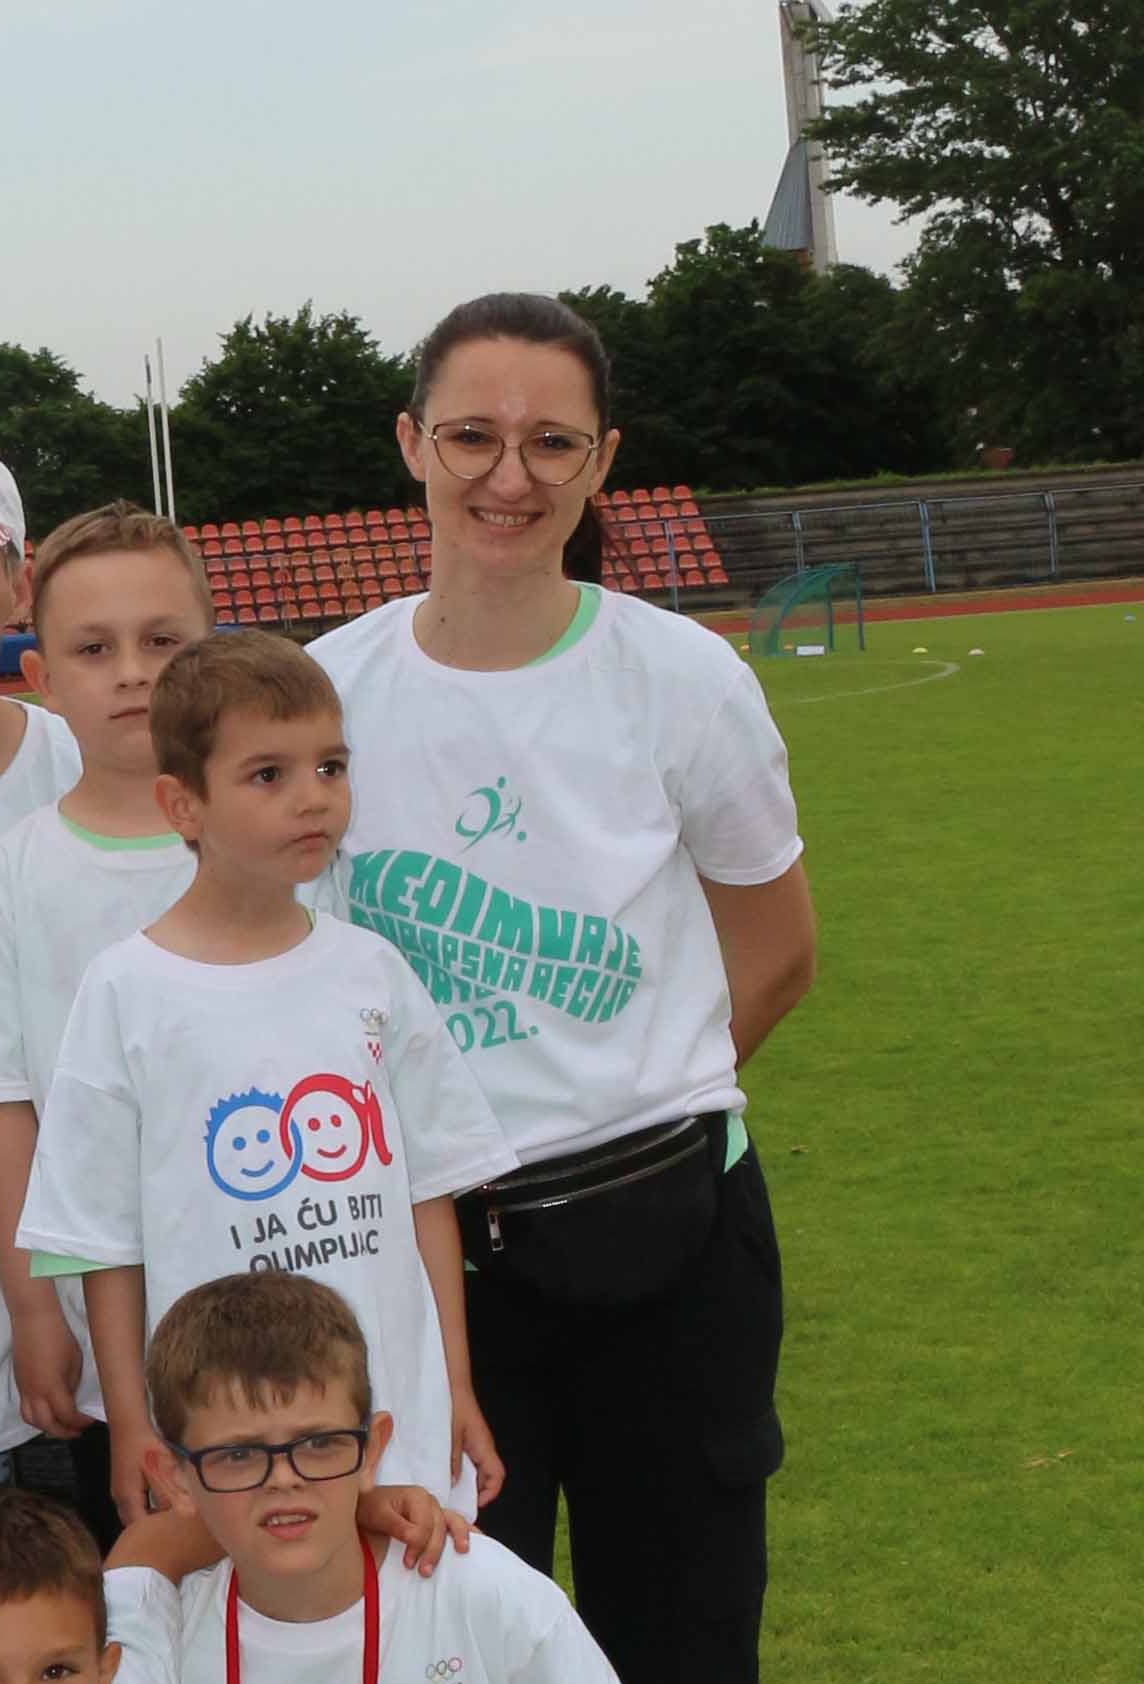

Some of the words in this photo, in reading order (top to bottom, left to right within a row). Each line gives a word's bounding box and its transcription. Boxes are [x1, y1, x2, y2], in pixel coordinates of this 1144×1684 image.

[446, 1001, 539, 1053] 022.
[230, 1224, 242, 1250] I
[253, 1213, 287, 1244] JA
[297, 1197, 338, 1231] ĆU
[347, 1194, 383, 1220] BITI
